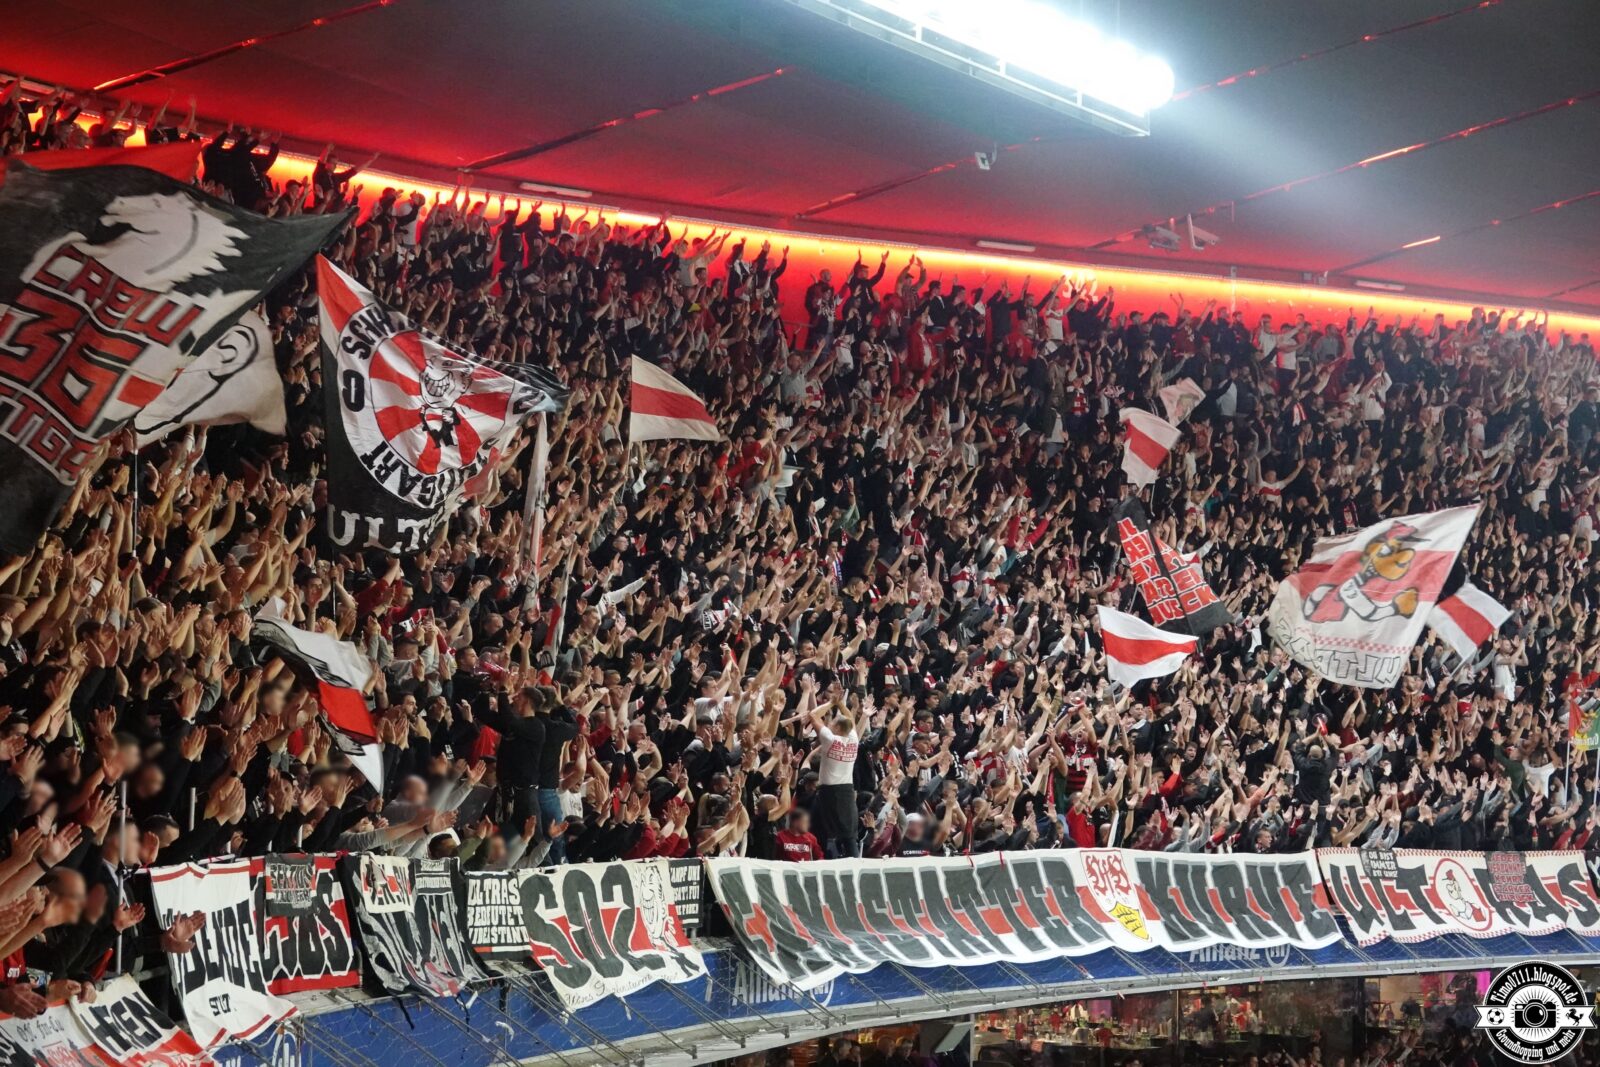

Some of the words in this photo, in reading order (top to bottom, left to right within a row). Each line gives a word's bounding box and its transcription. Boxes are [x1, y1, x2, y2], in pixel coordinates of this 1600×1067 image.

[32, 244, 206, 348] CREW
[0, 290, 148, 434] 36
[468, 878, 521, 906] ULTRAS
[717, 858, 1113, 981] CANNSTATTER
[1135, 857, 1339, 943] KURVE
